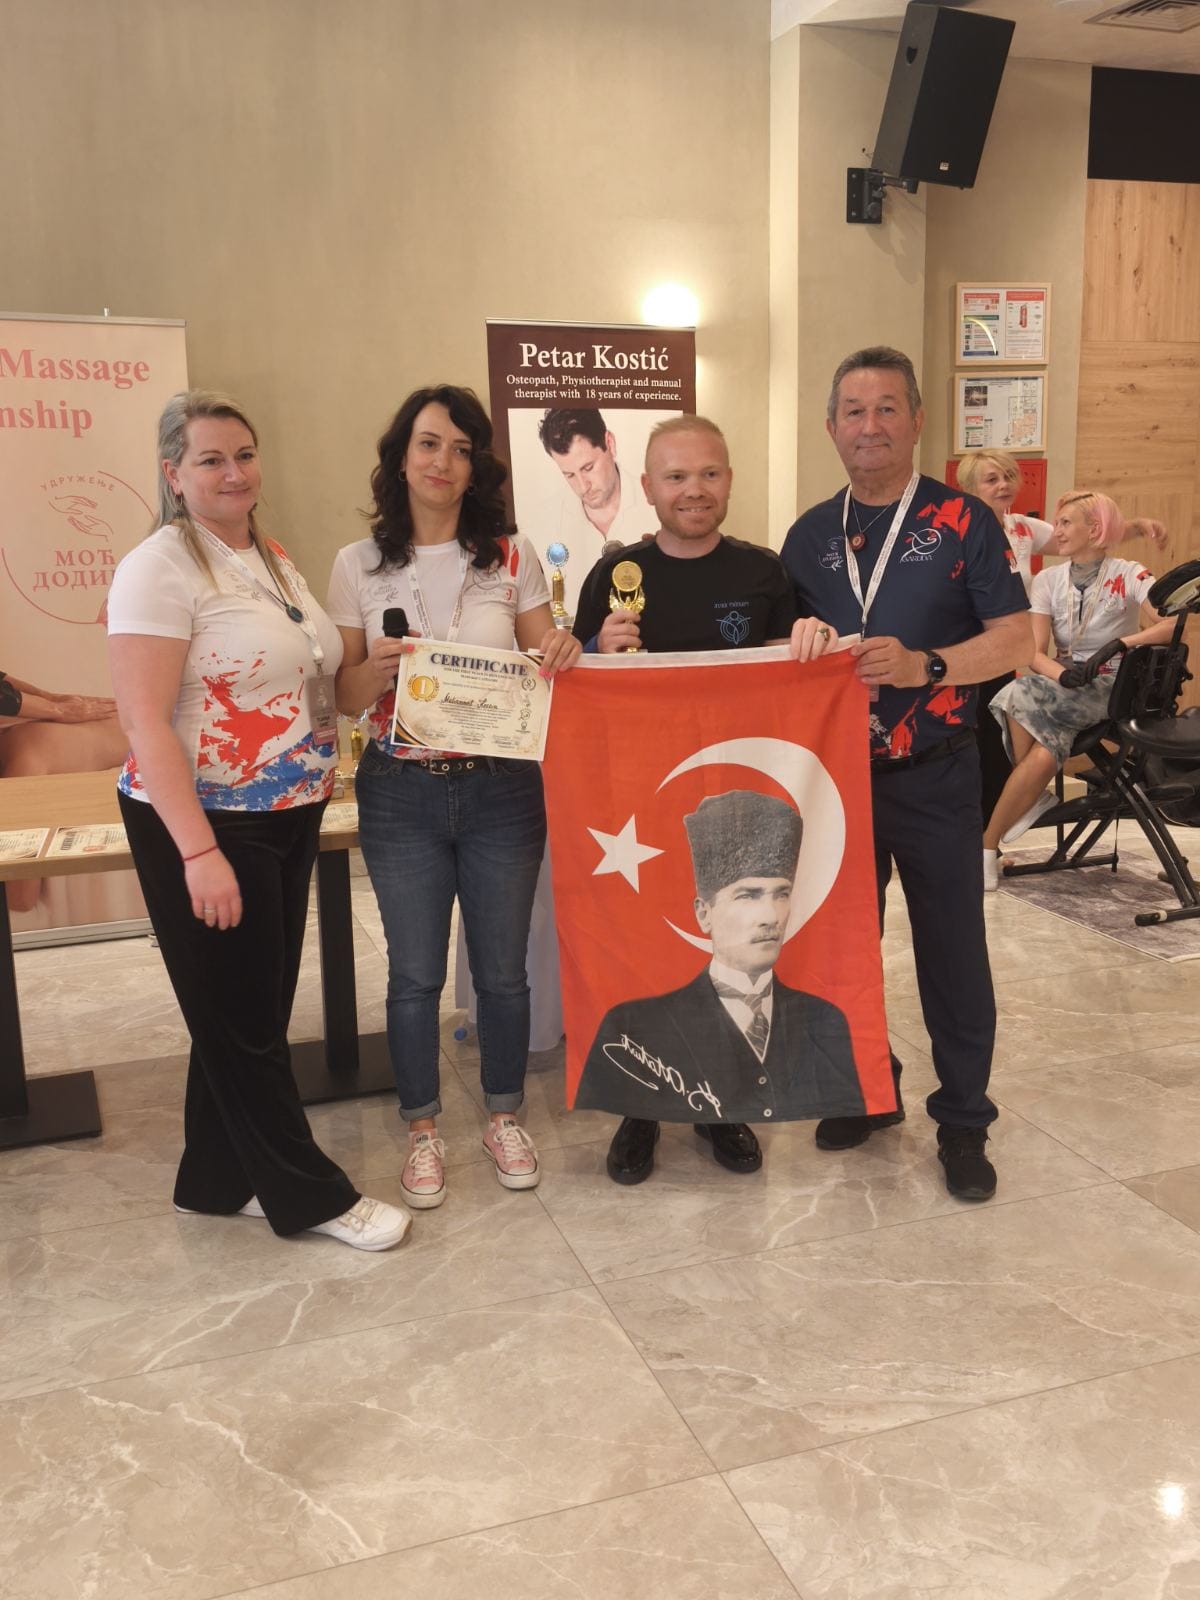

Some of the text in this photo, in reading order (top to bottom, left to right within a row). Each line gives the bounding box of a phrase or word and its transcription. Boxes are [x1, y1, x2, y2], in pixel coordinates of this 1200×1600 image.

[519, 343, 669, 371] Petar Kostić
[0, 348, 150, 389] Massage
[506, 374, 682, 388] Osteopath, Physiotherapist and manual
[515, 388, 682, 402] therapist with 18 years of experience.
[40, 475, 116, 491] УДРУЖЕЊЕ
[55, 549, 116, 567] МОЋ
[32, 569, 116, 592] ДОДИ
[430, 652, 528, 676] CERTIFICATE
